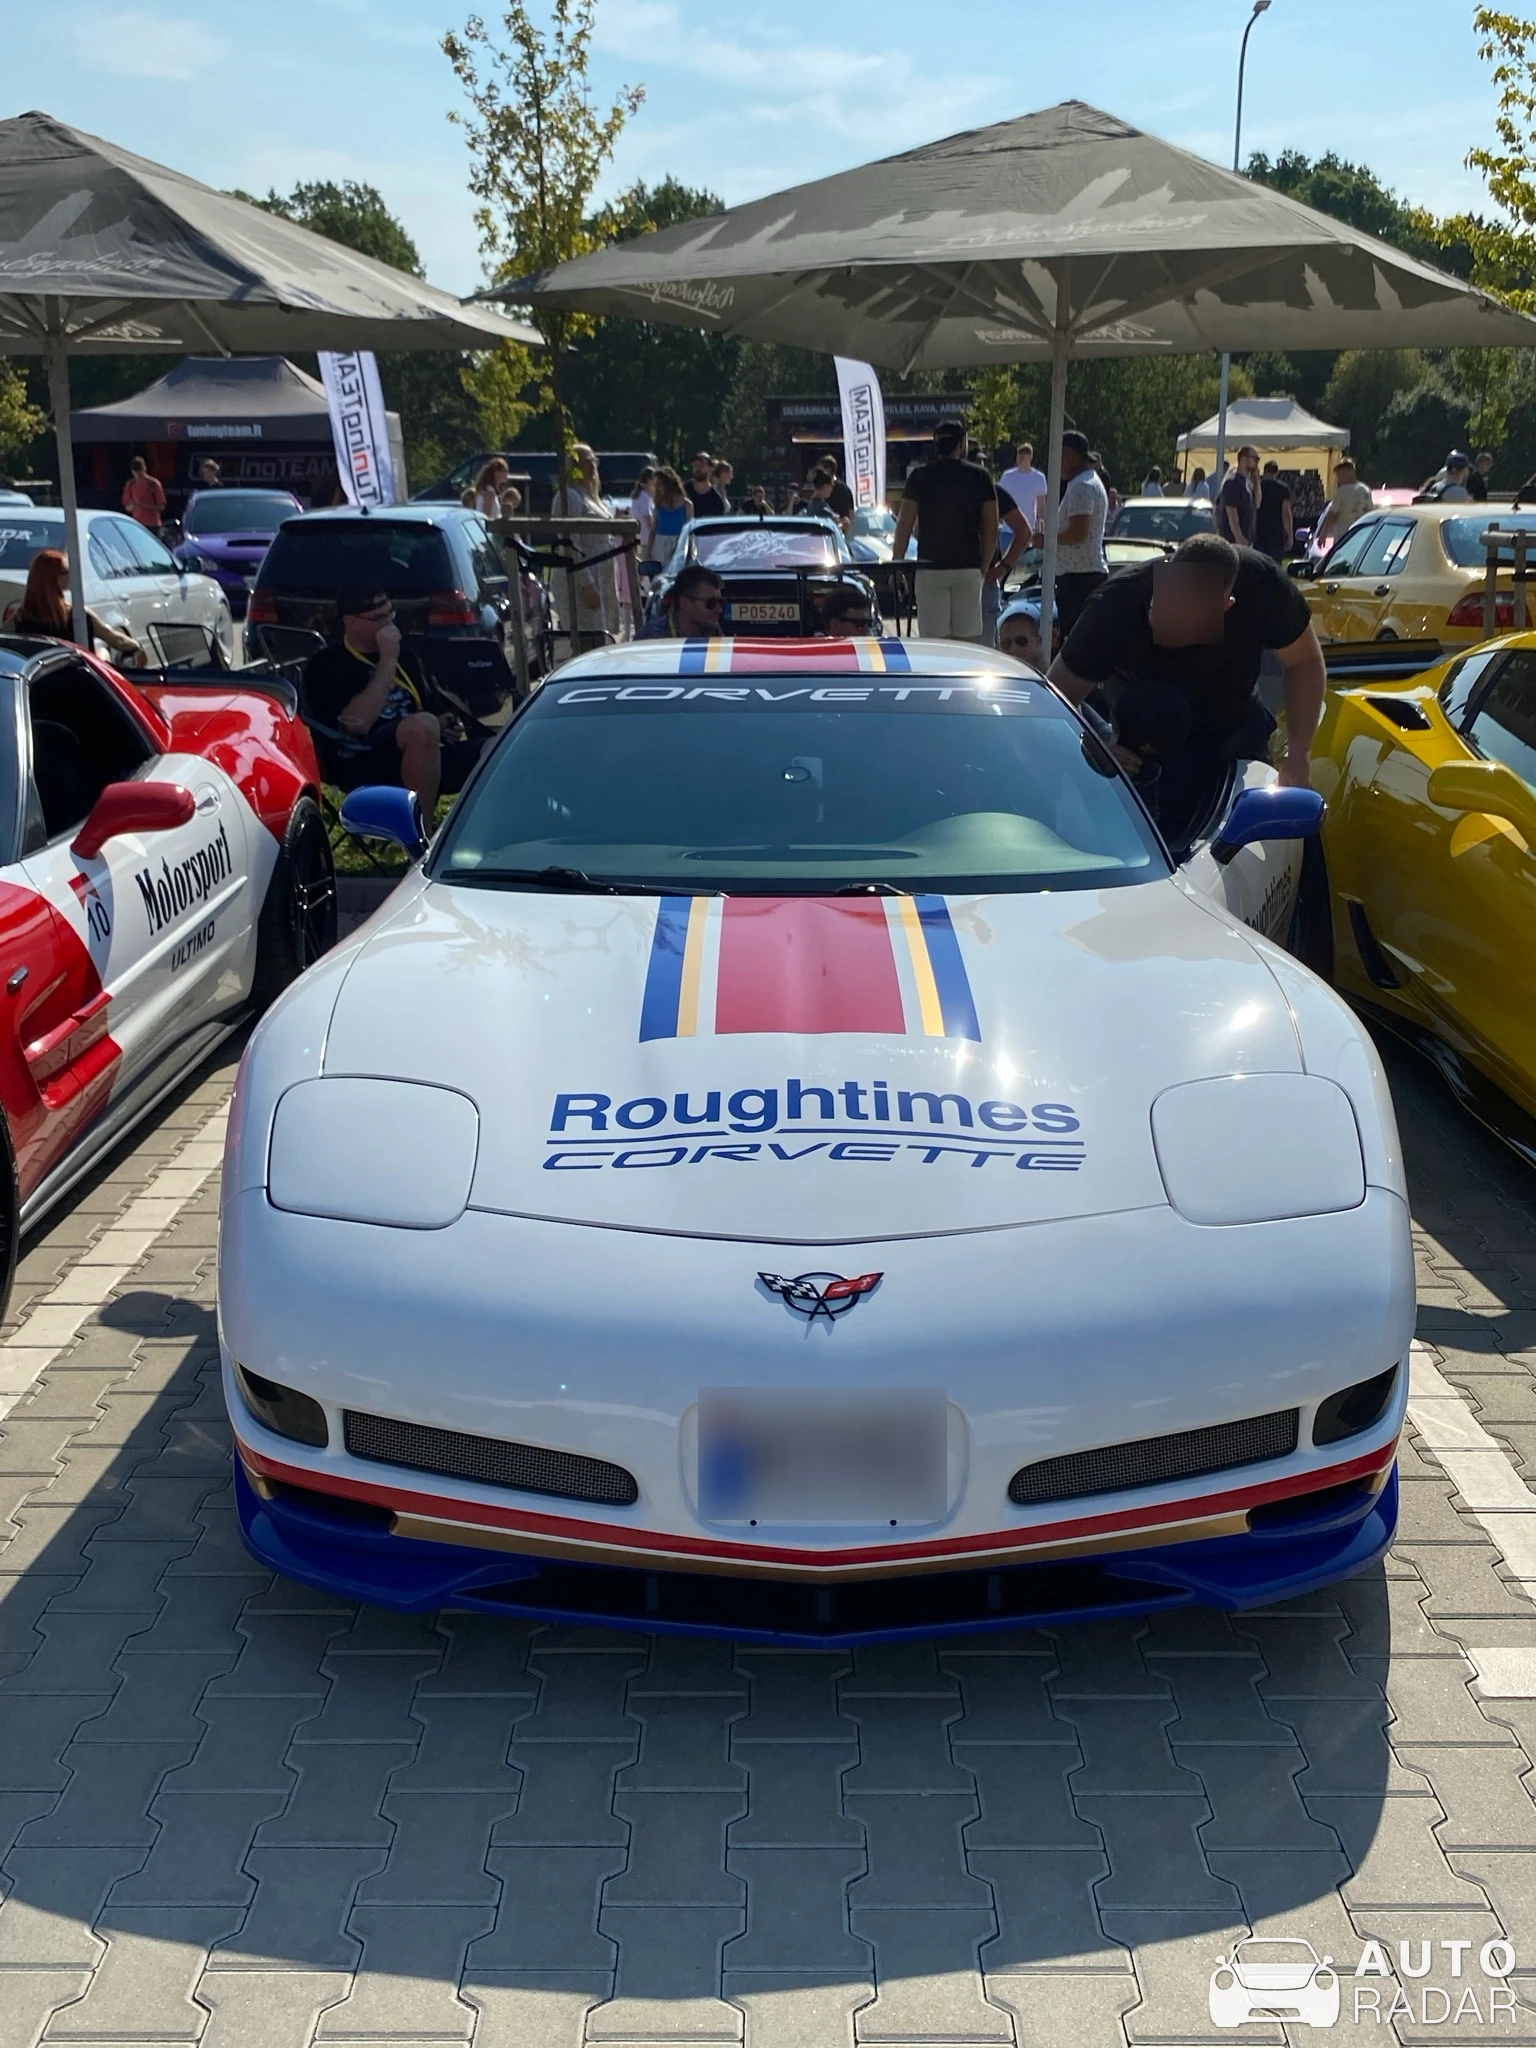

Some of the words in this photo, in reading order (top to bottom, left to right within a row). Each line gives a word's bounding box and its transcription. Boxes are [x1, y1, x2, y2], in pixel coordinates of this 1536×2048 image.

[557, 686, 1031, 704] CORVETTE
[135, 818, 233, 936] Motorsport
[87, 899, 111, 944] 10
[171, 920, 216, 973] ULTIMO
[549, 1078, 1081, 1134] Roughtimes
[542, 1142, 1087, 1172] CORVETTE
